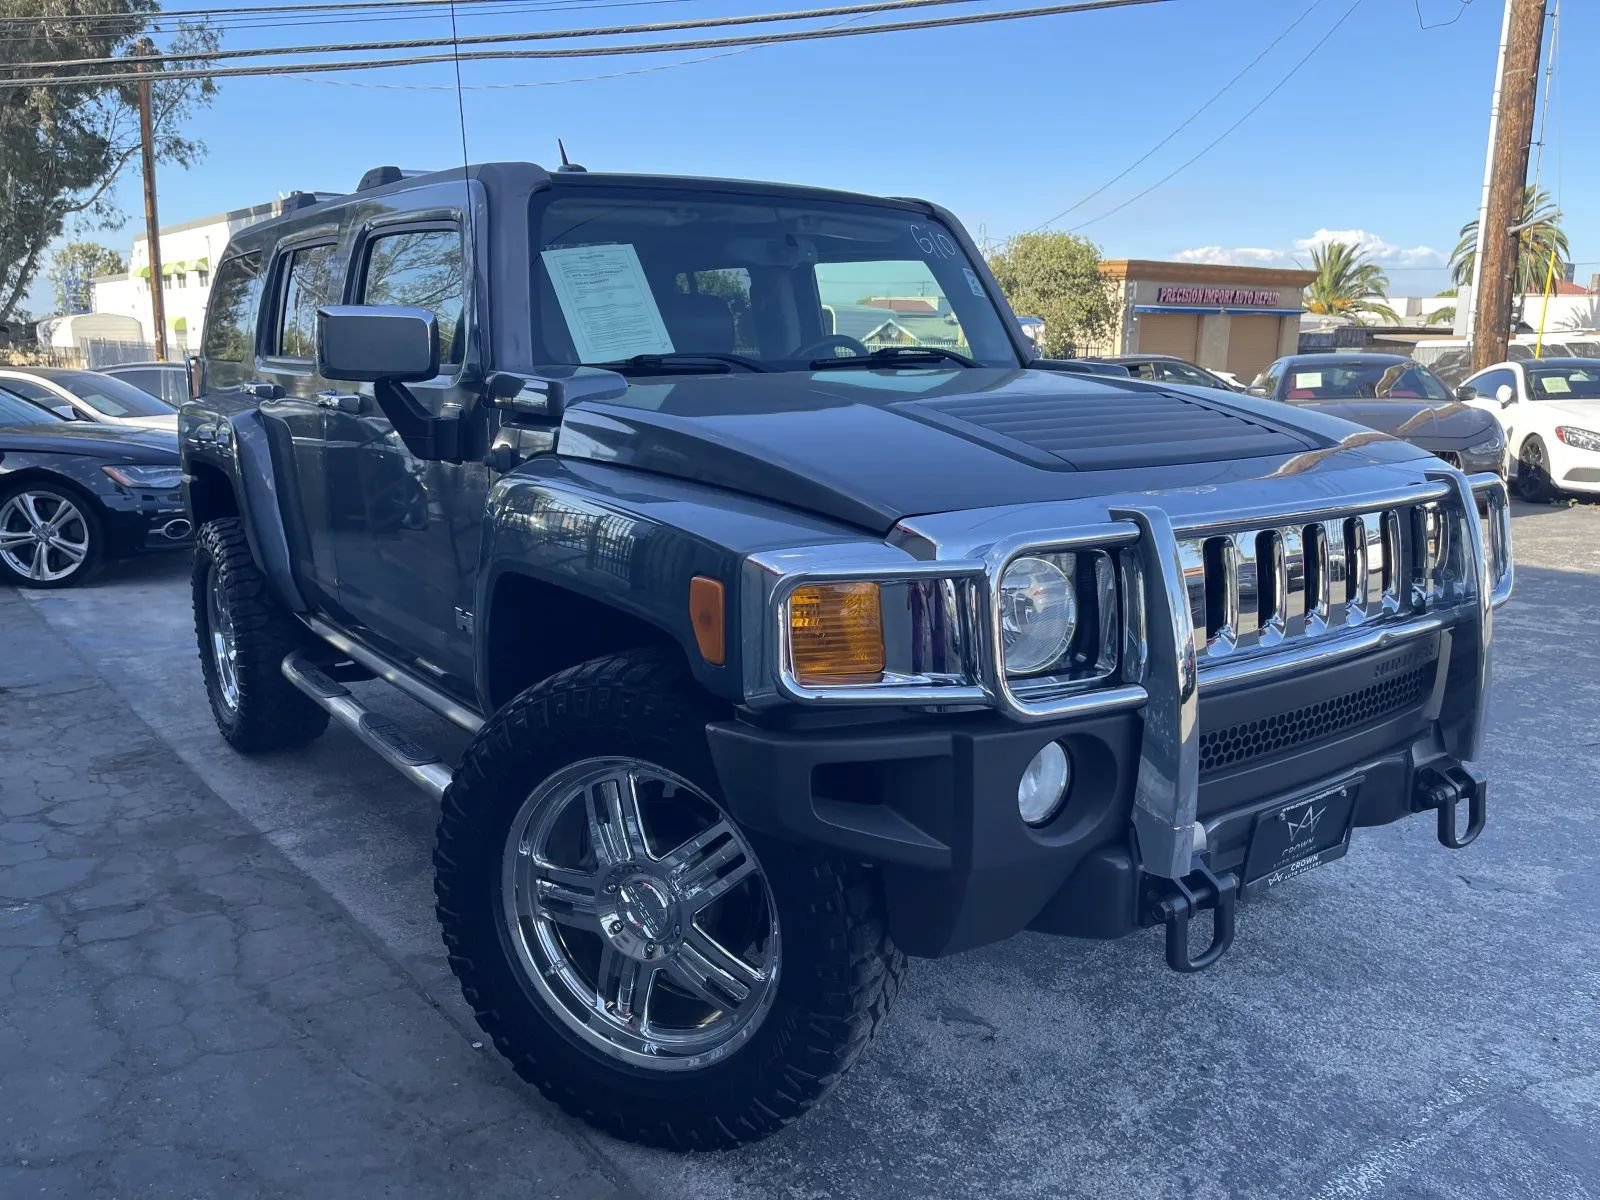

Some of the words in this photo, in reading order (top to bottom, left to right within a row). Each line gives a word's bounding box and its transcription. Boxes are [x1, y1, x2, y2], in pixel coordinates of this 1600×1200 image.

[1159, 288, 1205, 303] PRECISION
[1203, 288, 1236, 304] IMPORT
[1233, 289, 1254, 304] AUTO
[1253, 291, 1280, 305] REPAIR
[1290, 853, 1319, 871] CROWN
[1284, 871, 1298, 880] AUTO
